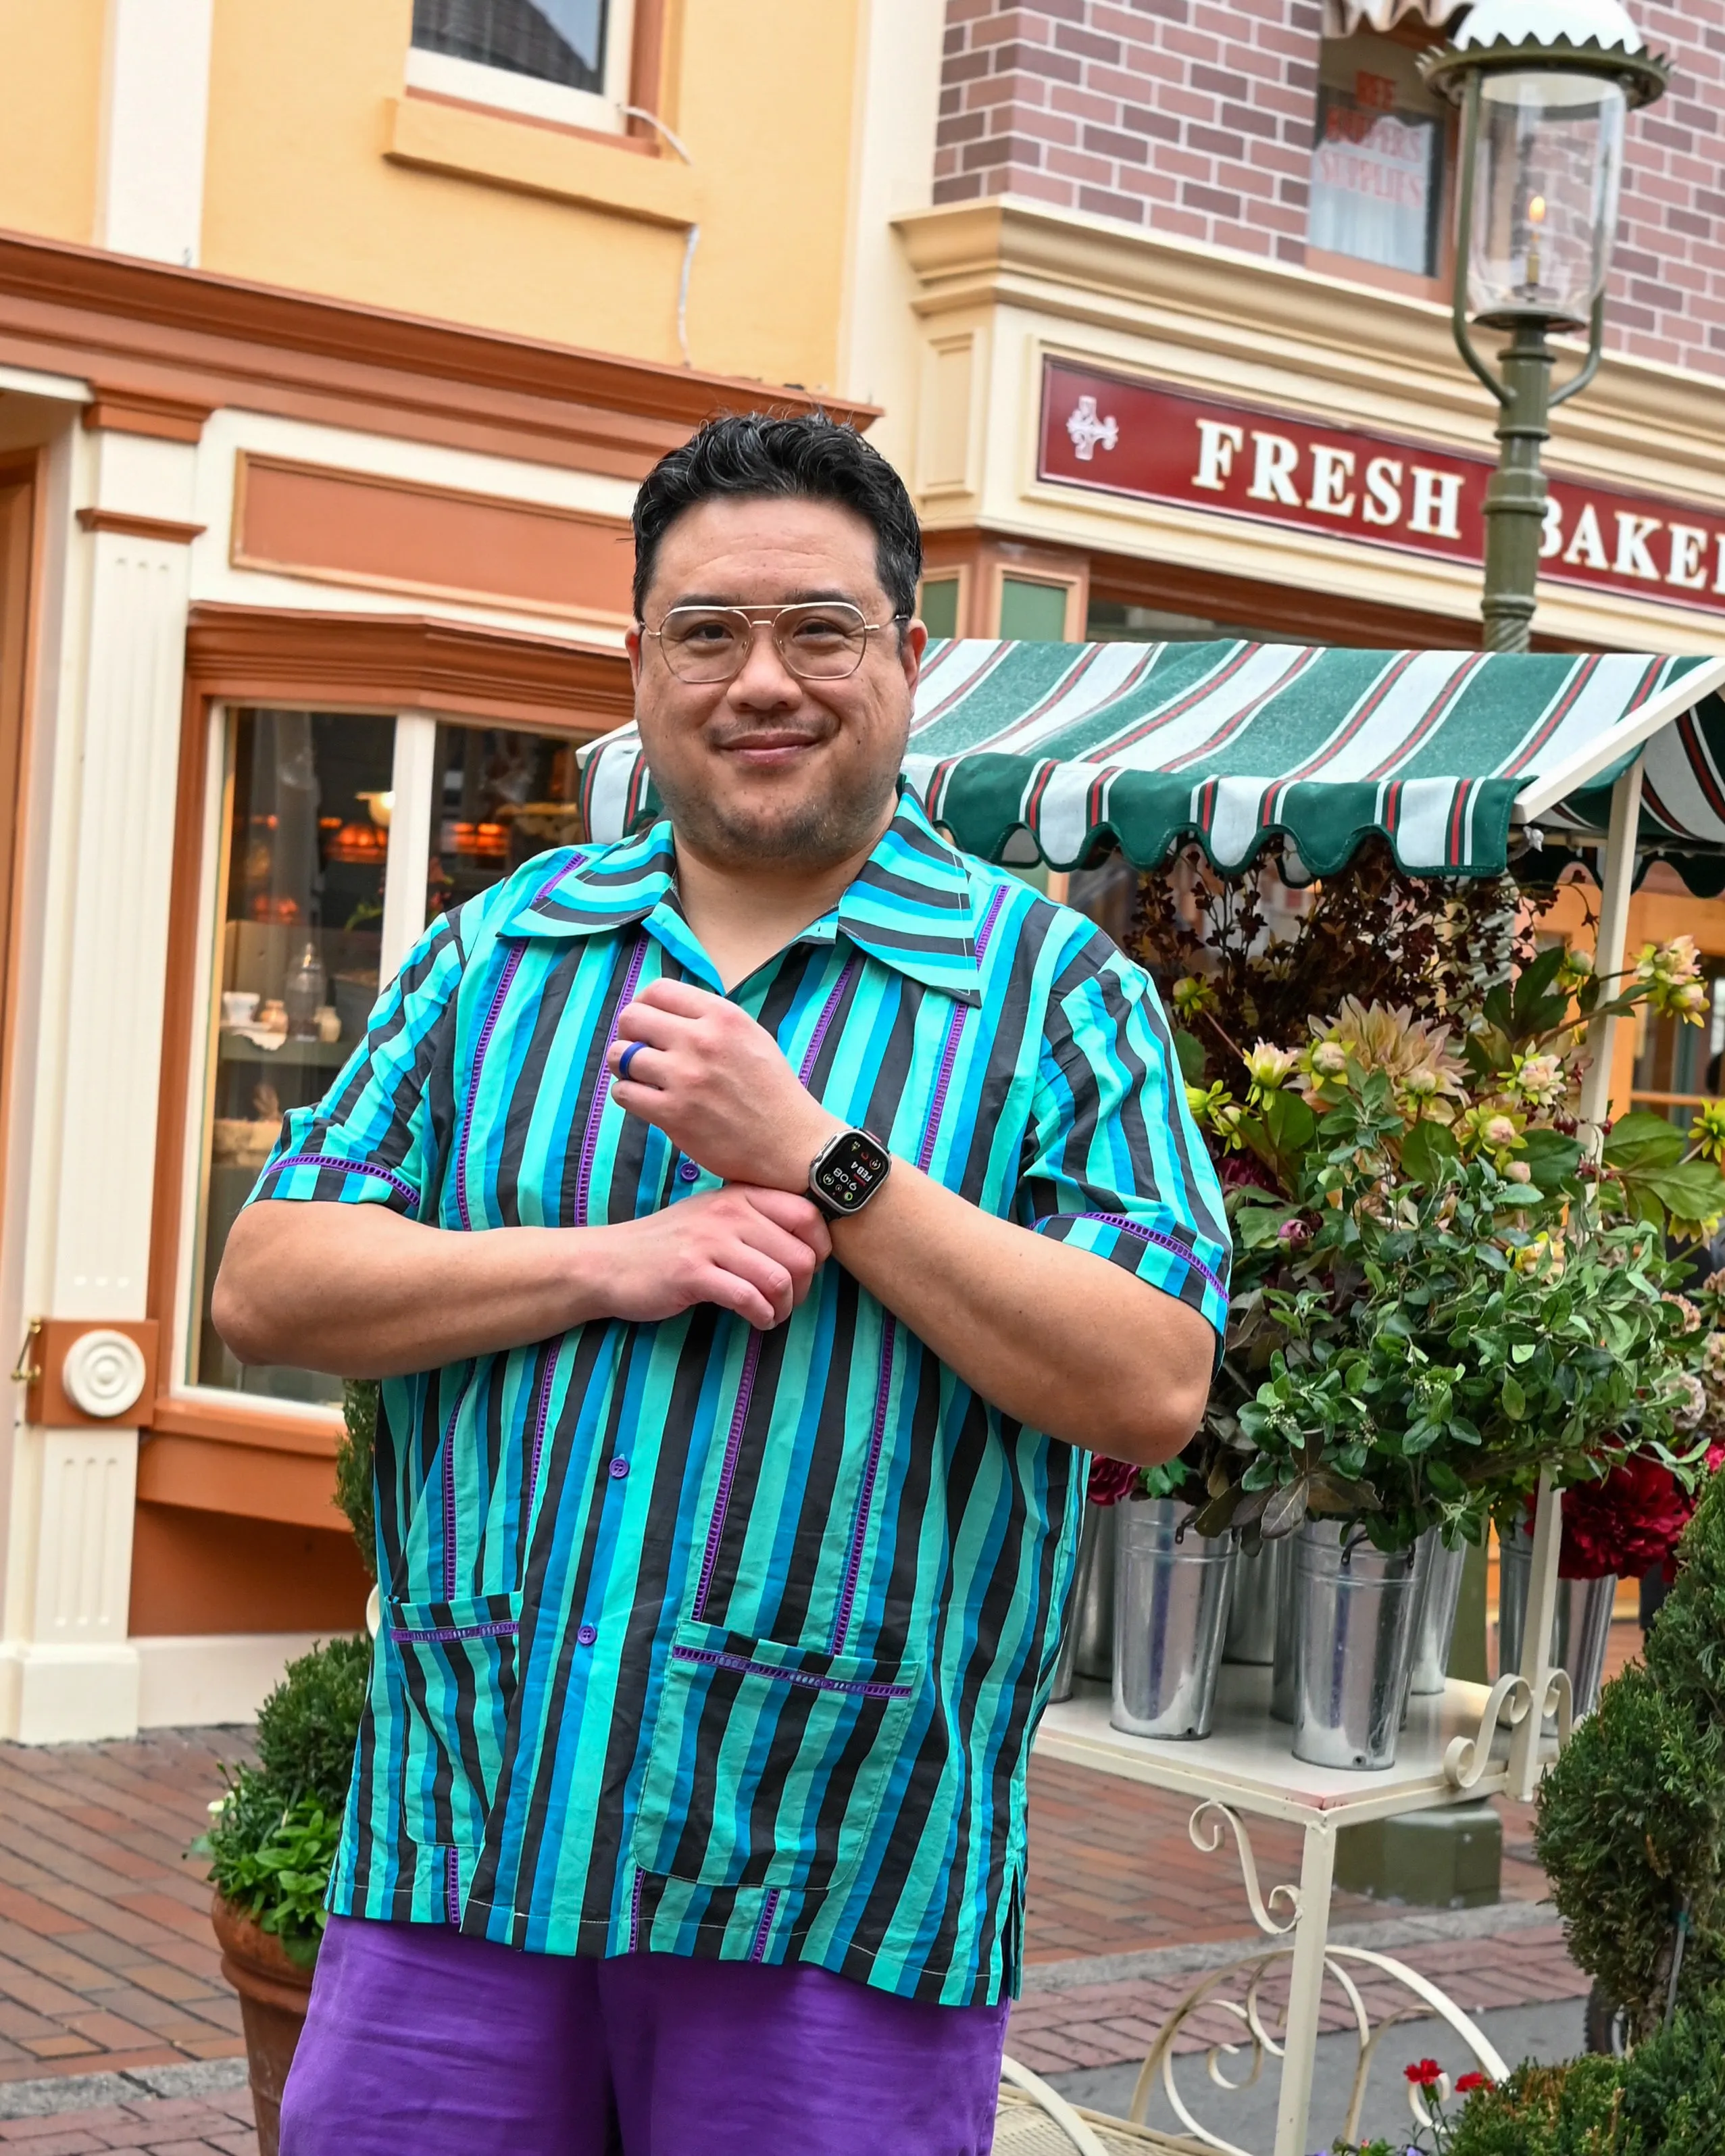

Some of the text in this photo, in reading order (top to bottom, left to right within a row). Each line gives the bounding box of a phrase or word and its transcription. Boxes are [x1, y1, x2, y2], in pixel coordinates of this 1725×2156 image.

[1319, 149, 1426, 209] SUPPLIES
[1191, 418, 1725, 595] FRESH BAKE
[851, 1161, 858, 1170] 4
[857, 1167, 873, 1182] FEB
[833, 1168, 857, 1190] 9:08
